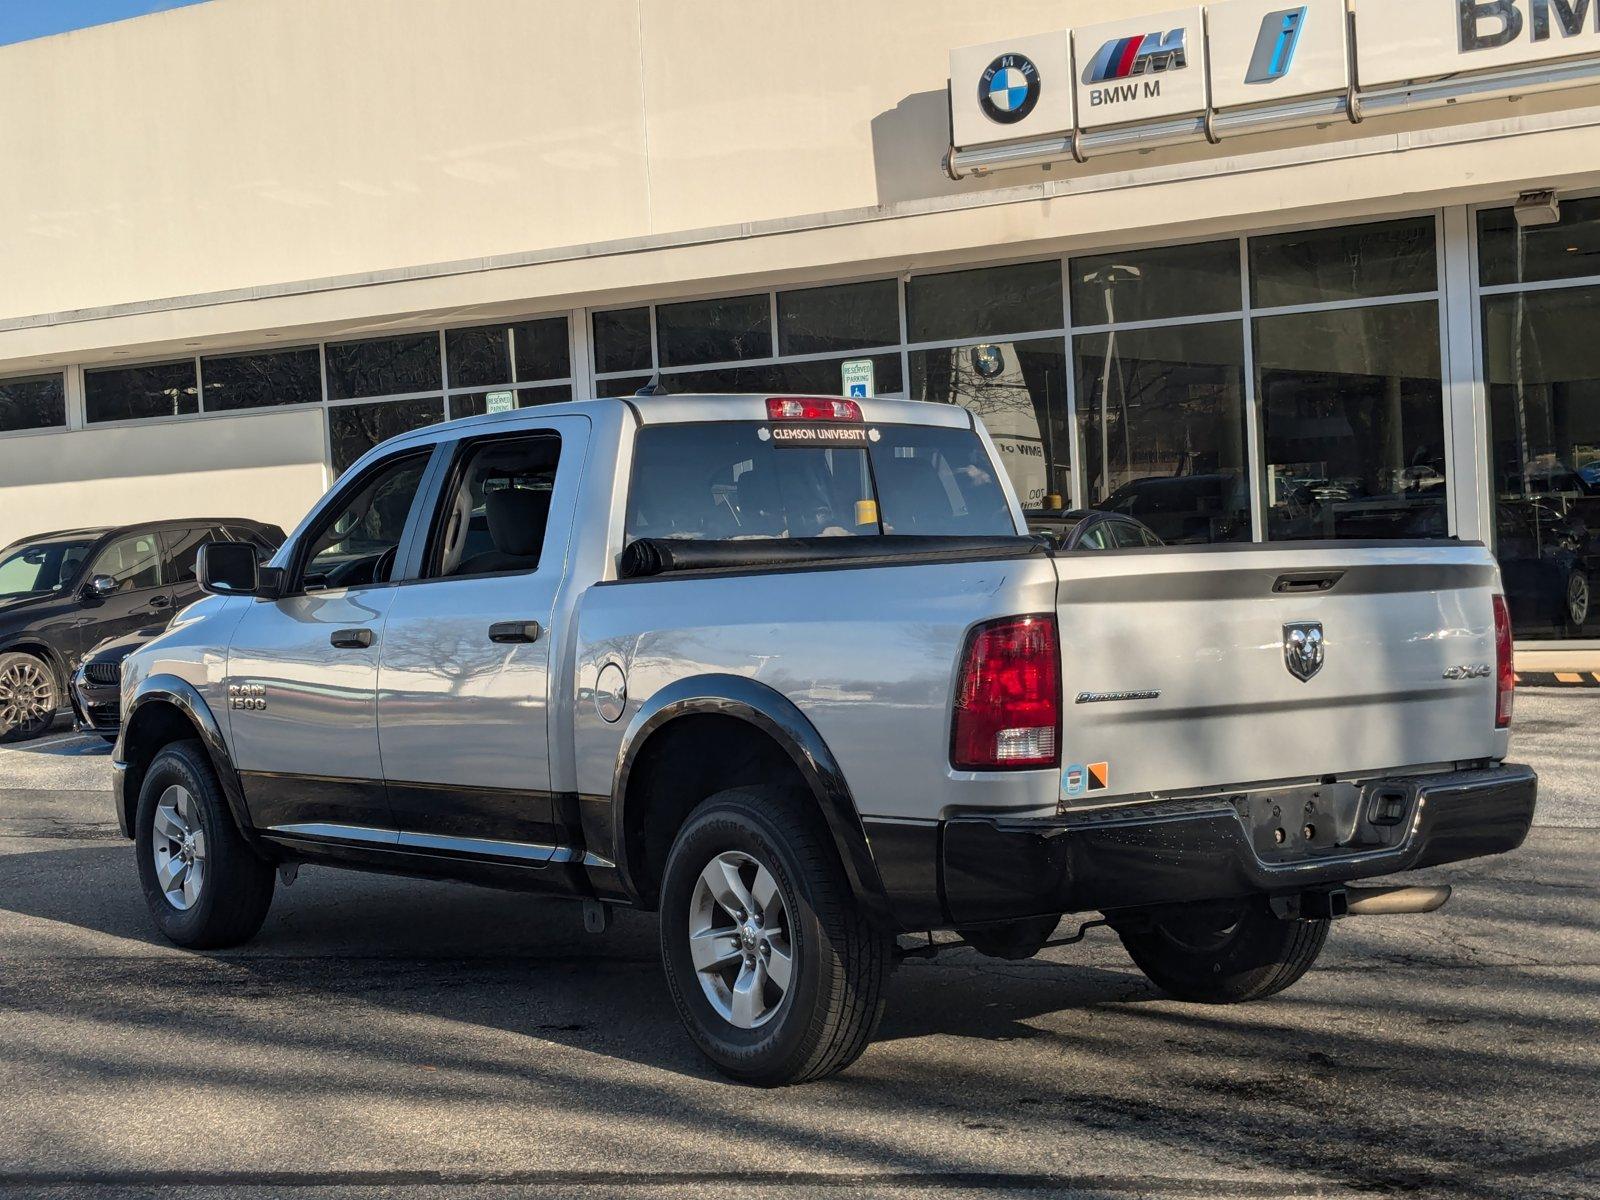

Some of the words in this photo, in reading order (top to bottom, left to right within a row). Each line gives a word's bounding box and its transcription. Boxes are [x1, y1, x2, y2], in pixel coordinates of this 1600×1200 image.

[984, 56, 1034, 81] BMW
[1090, 83, 1138, 106] BMW
[1143, 80, 1160, 98] M
[846, 375, 868, 383] PARKING
[773, 429, 815, 439] CLEMSON
[817, 429, 866, 440] UNIVERSITY
[229, 684, 266, 696] RAM
[229, 698, 266, 710] 1500
